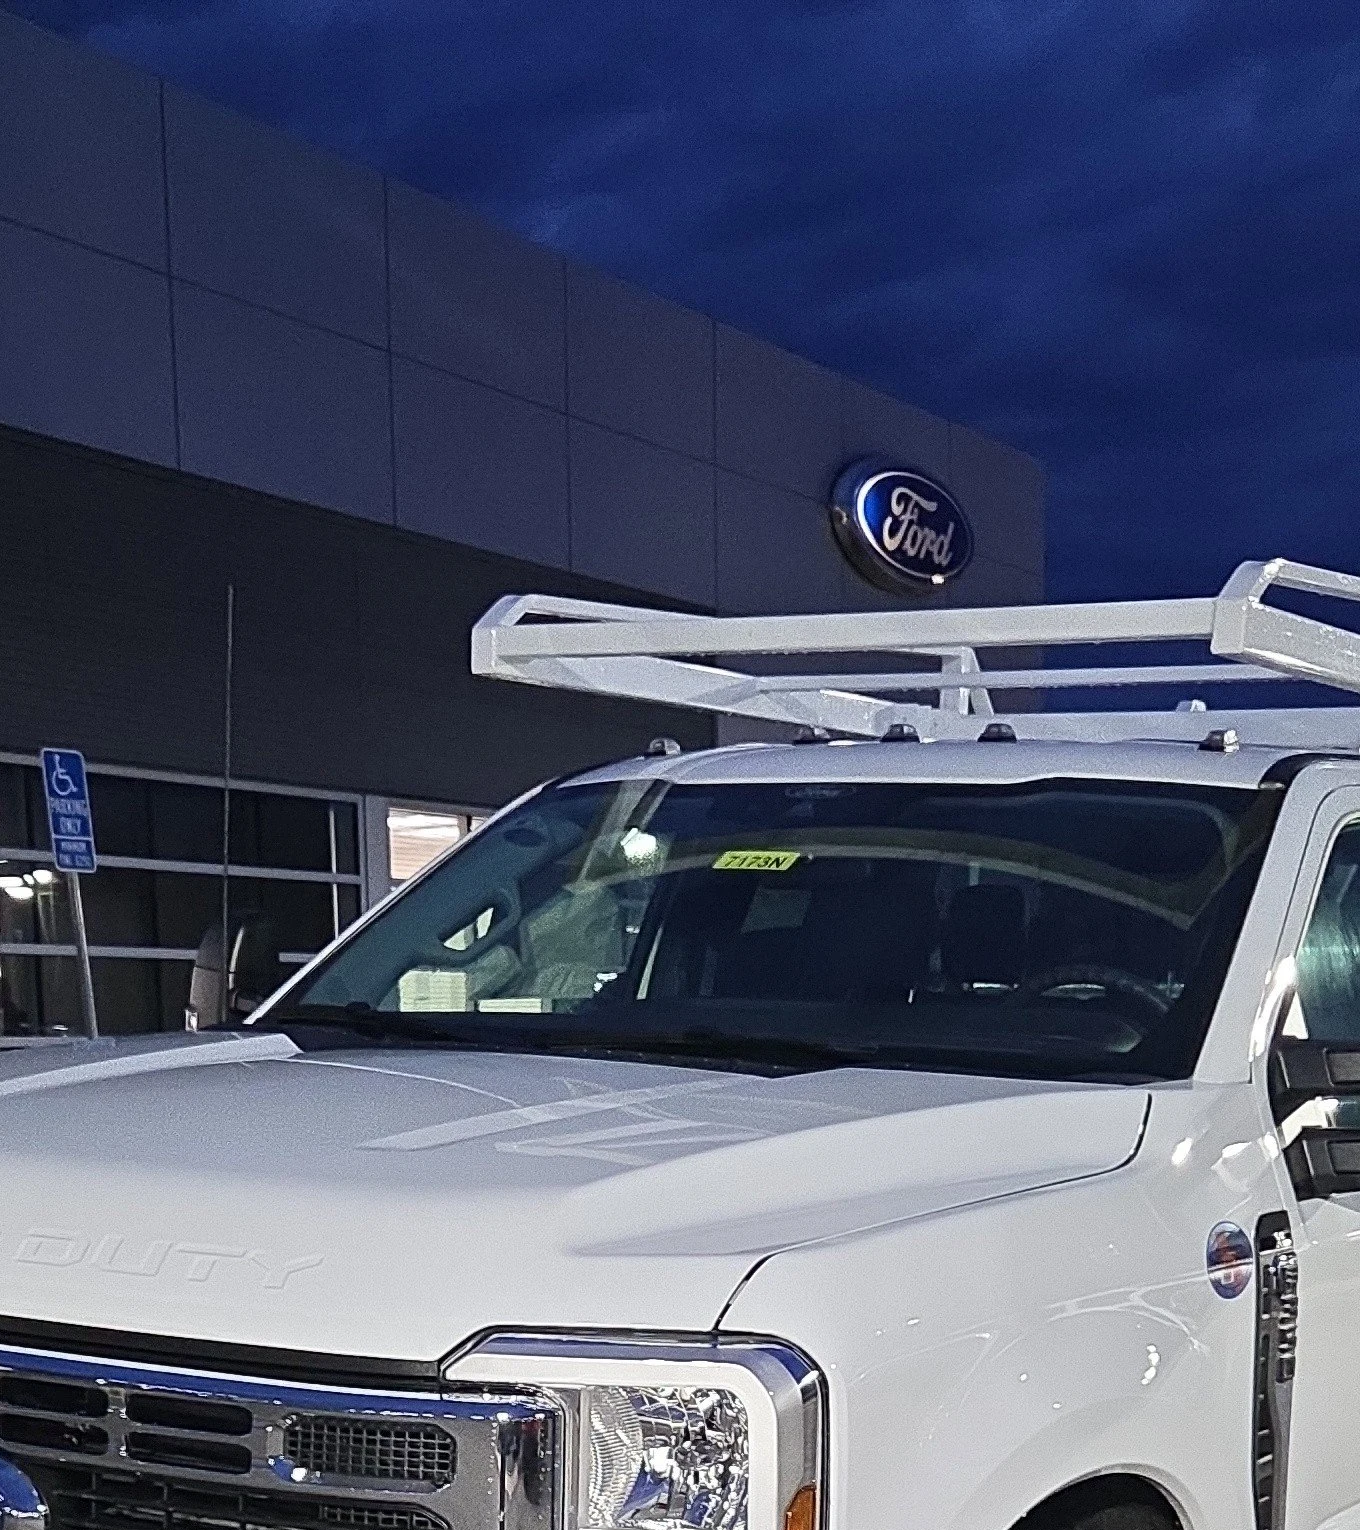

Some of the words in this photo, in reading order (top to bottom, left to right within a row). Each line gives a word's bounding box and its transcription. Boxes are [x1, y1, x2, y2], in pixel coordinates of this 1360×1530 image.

[883, 487, 955, 567] Ford
[724, 855, 788, 869] 7173N
[14, 1227, 326, 1291] DUTY
